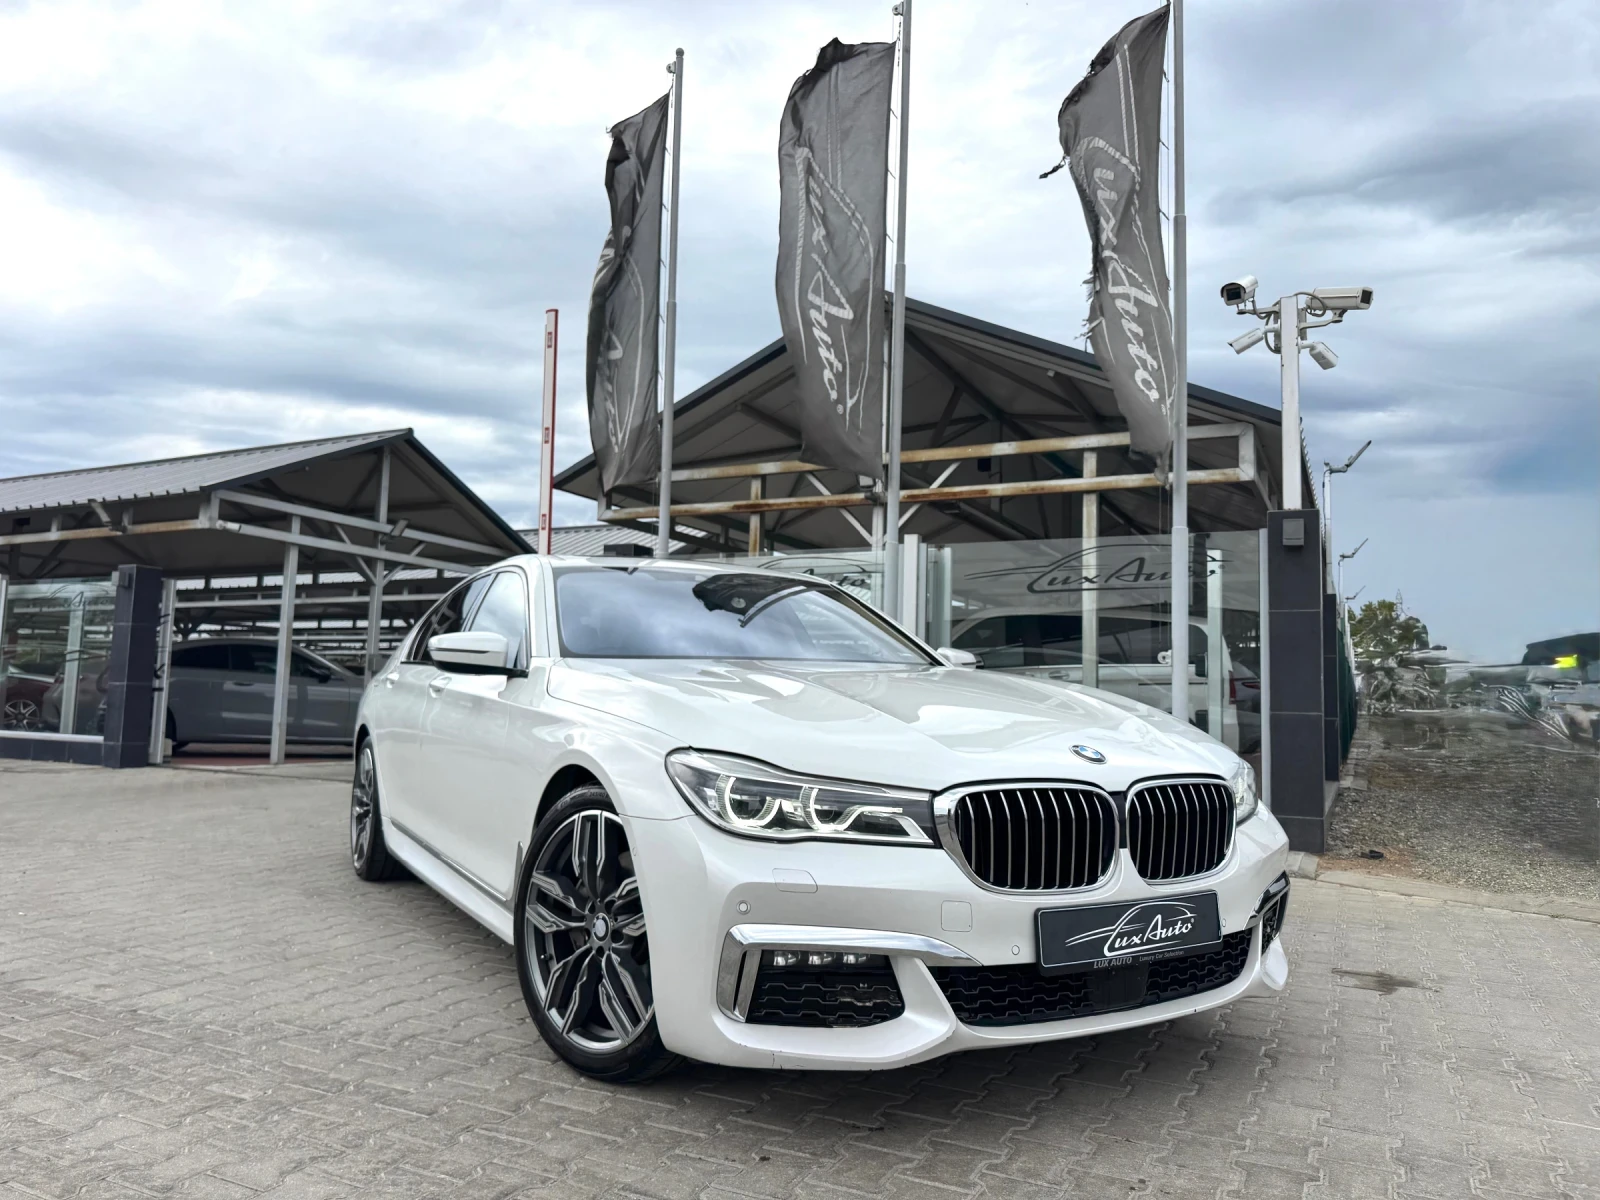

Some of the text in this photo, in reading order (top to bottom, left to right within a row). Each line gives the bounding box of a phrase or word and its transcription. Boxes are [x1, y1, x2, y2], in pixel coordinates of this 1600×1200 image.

[808, 253, 854, 402] Auto
[1102, 249, 1159, 402] Auto
[1093, 959, 1109, 968] LUX
[1110, 956, 1133, 967] AUTO
[1143, 914, 1194, 943] Auto
